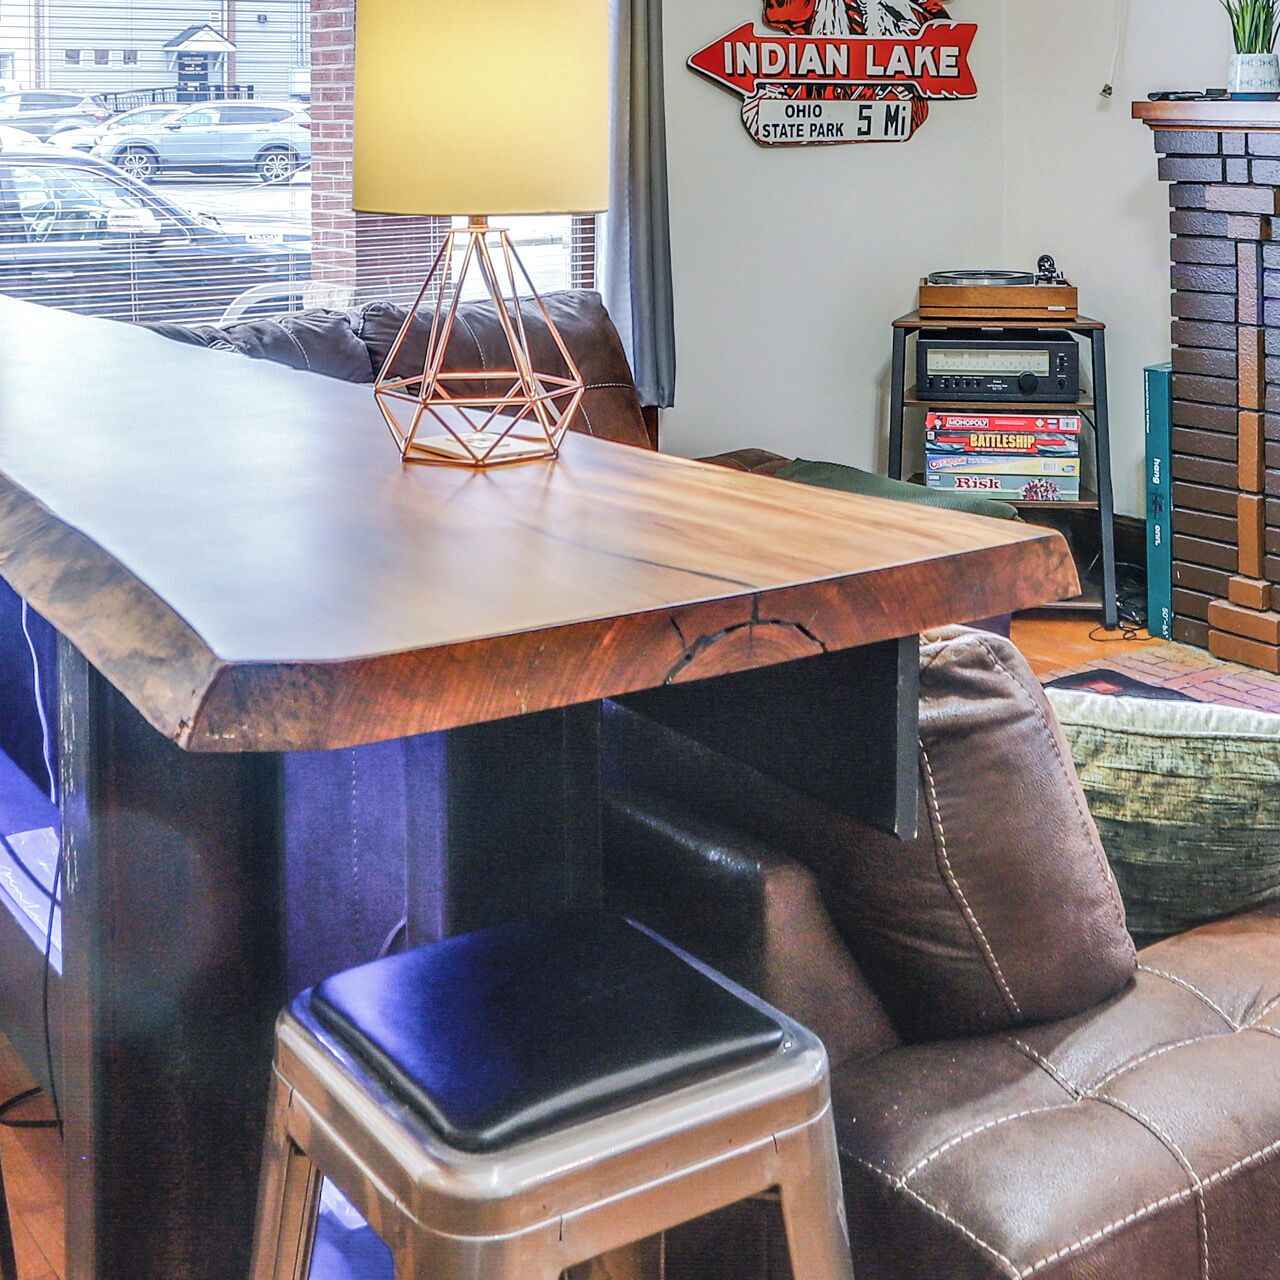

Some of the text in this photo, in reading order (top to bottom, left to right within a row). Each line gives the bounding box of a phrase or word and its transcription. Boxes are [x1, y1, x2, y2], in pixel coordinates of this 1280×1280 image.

[723, 42, 959, 77] INDIAN LAKE
[785, 104, 822, 118] OHIO
[857, 104, 906, 136] 5 Mi
[762, 123, 844, 138] STATE PARK
[948, 418, 988, 427] MONOPOLY
[970, 433, 1036, 449] BATTLESHIP
[1152, 458, 1161, 485] hang
